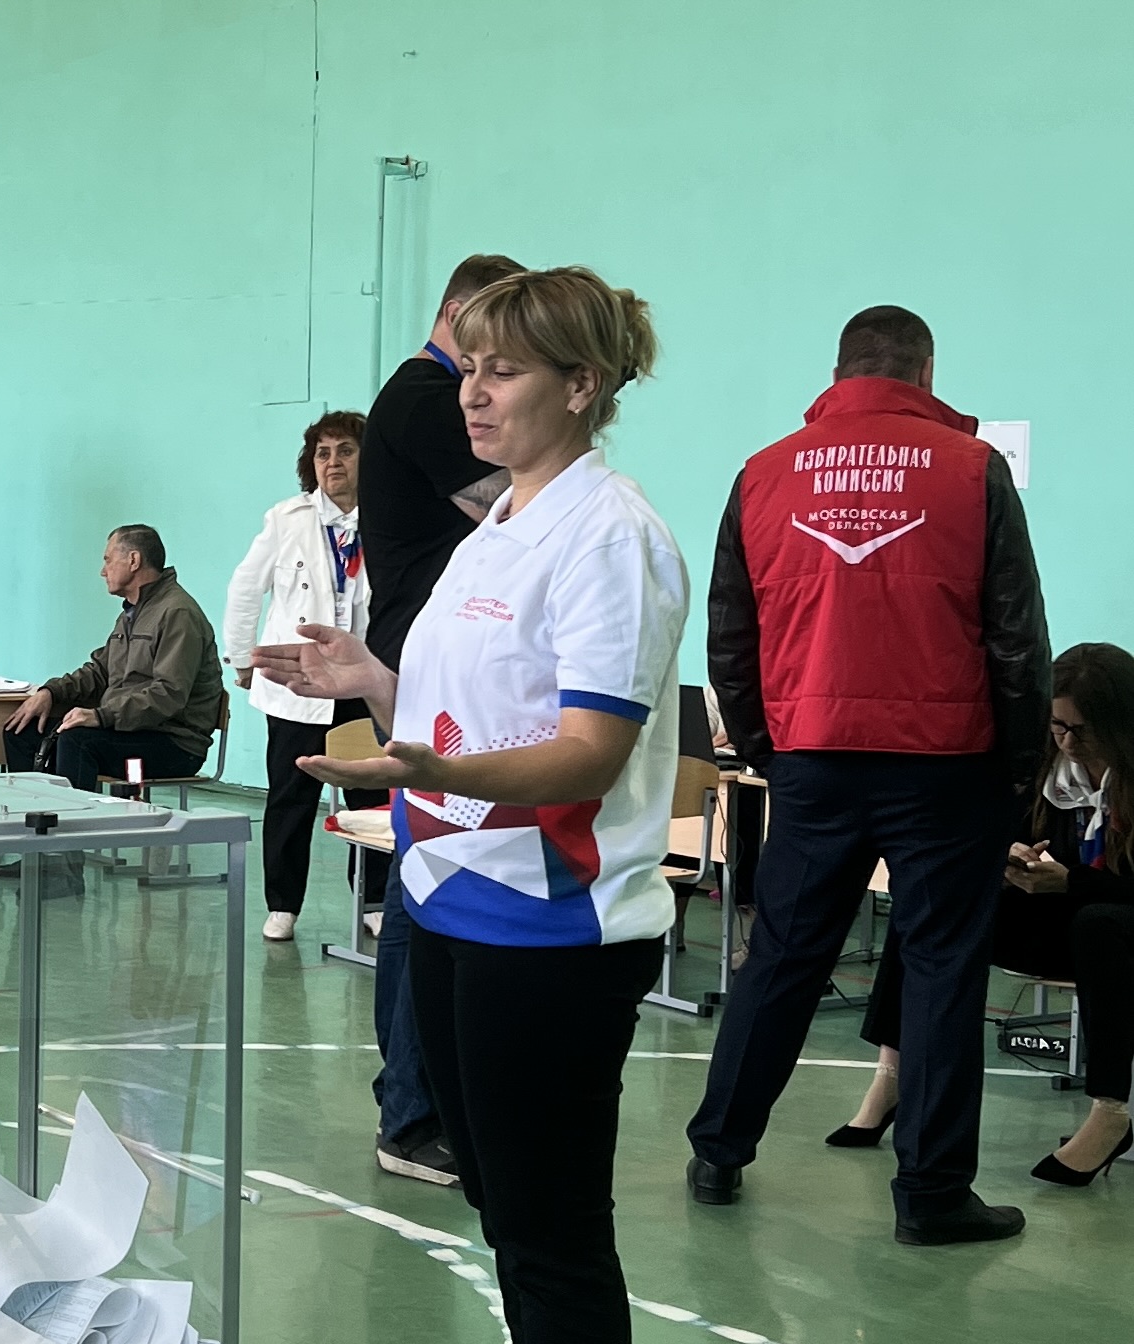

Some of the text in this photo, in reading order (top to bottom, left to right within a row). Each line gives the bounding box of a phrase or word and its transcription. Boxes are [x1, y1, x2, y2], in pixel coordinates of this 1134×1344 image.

[793, 444, 933, 473] ИЗБИРАТЕЛЬНАЯ
[813, 468, 906, 495] КОМИССИЯ
[807, 508, 908, 523] МОСКОВСКАЯ
[828, 521, 883, 531] ОБЛАСТЬ
